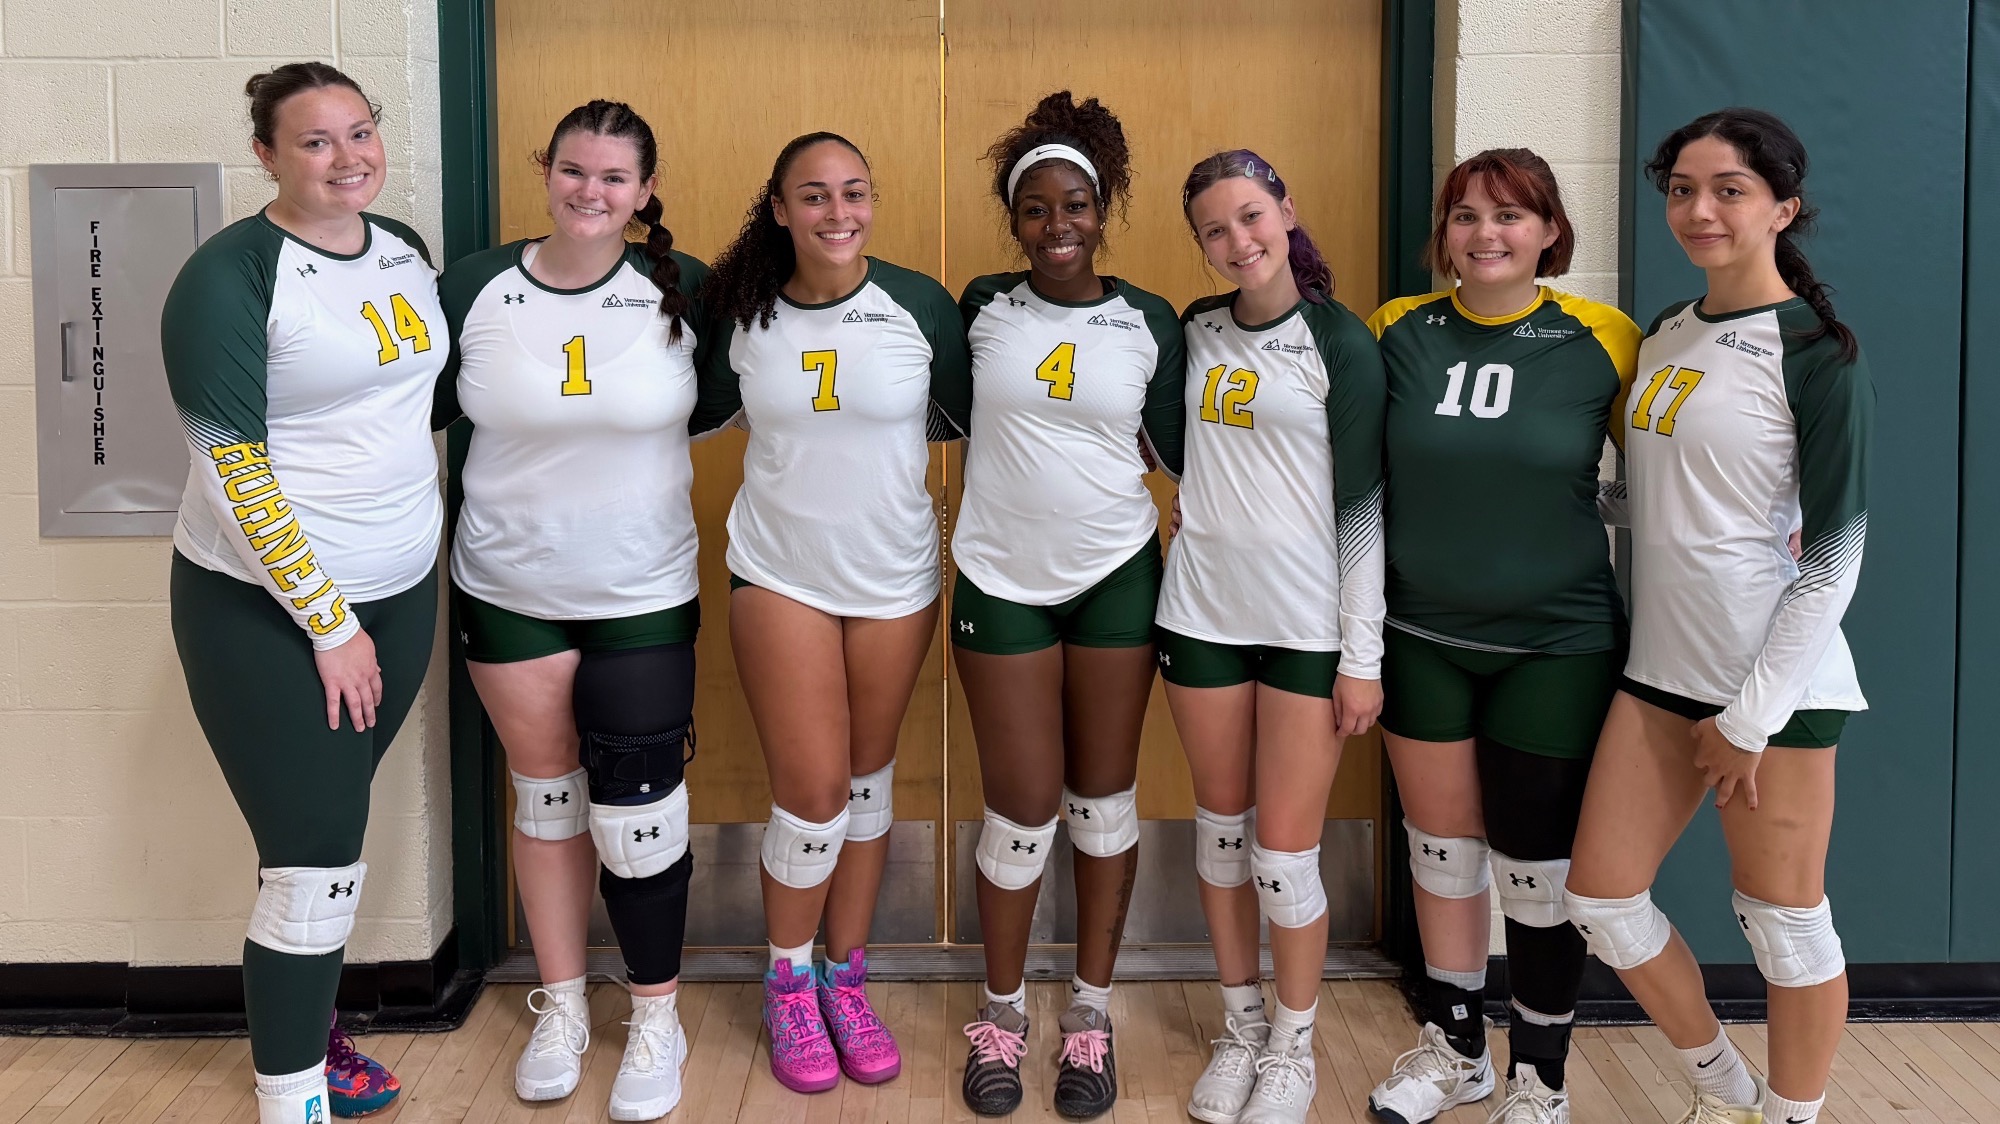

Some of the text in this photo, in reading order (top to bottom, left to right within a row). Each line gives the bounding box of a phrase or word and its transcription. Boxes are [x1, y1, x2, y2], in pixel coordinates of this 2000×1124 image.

[90, 221, 105, 466] FIRE EXTINGUISHER
[360, 293, 431, 366] 14
[560, 335, 592, 396] 1
[801, 349, 841, 412] 7
[1035, 341, 1076, 402] 4
[1199, 363, 1260, 430] 12
[1434, 361, 1514, 419] 10
[1631, 364, 1706, 437] 17
